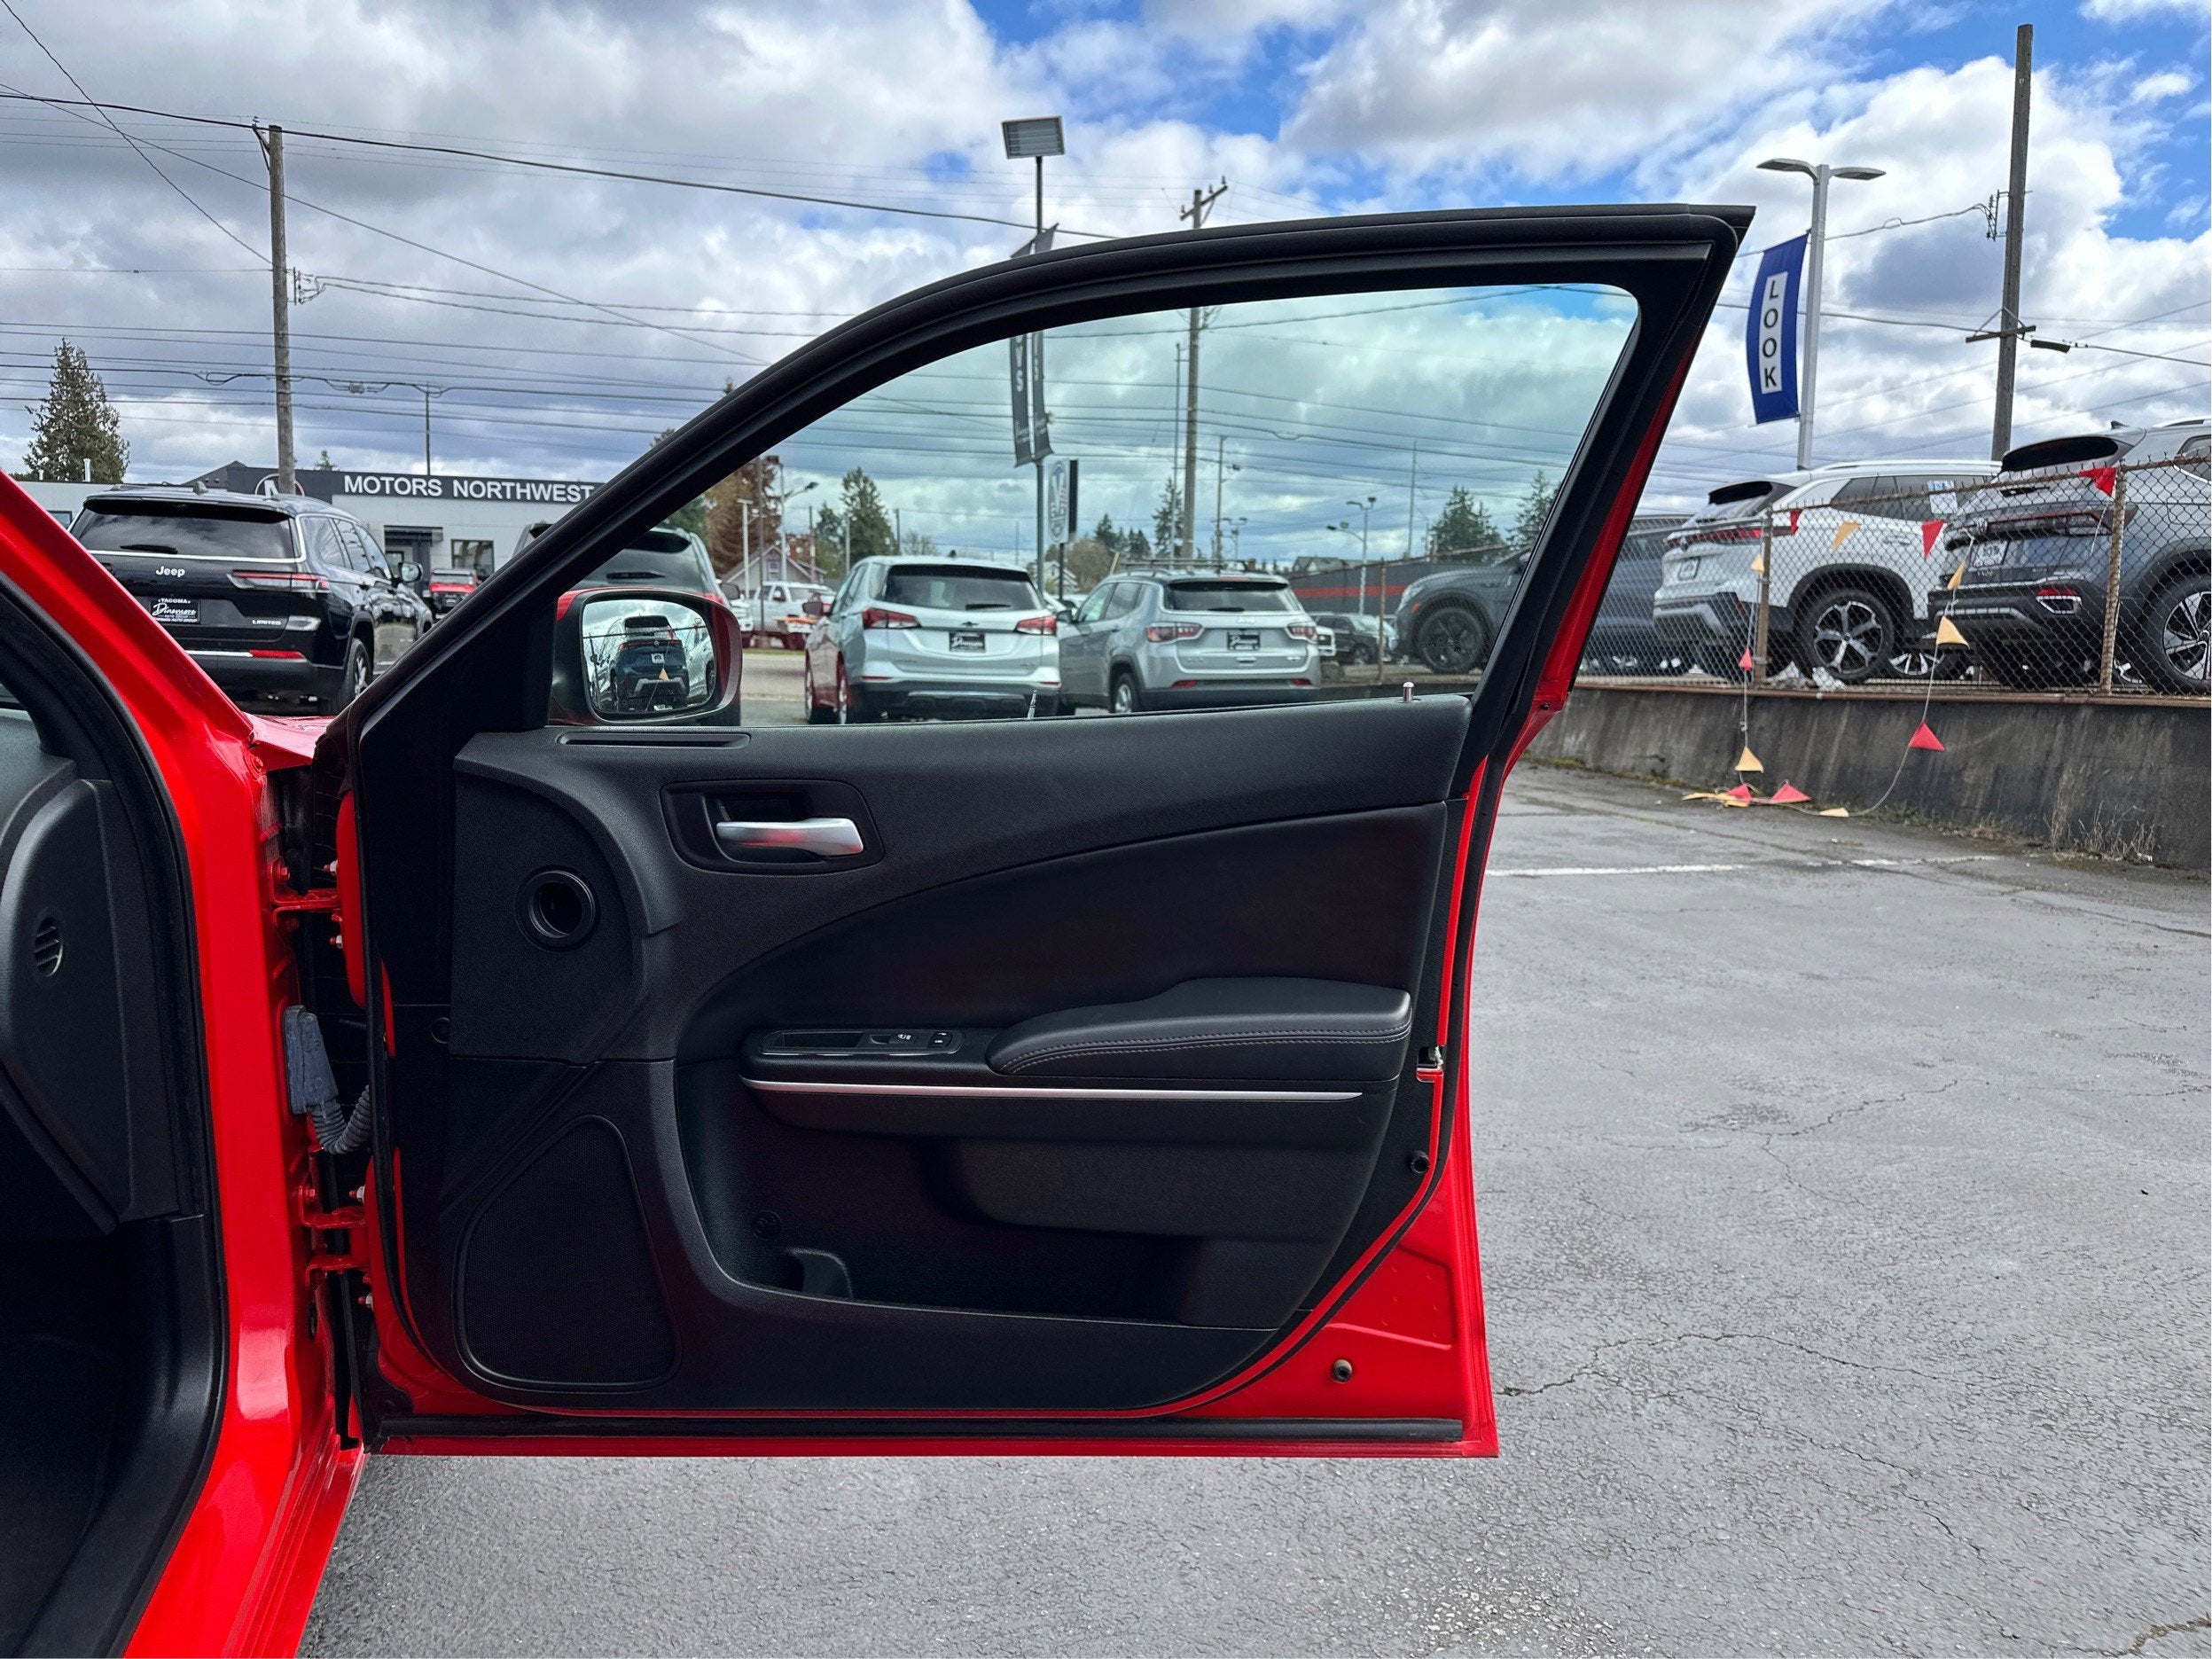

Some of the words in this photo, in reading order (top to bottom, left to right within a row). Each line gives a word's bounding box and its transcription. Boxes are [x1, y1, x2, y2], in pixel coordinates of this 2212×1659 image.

[1763, 280, 1778, 389] LOOK
[344, 475, 442, 497] MOTORS
[452, 480, 594, 503] NORTHWEST
[155, 566, 185, 578] Jeep
